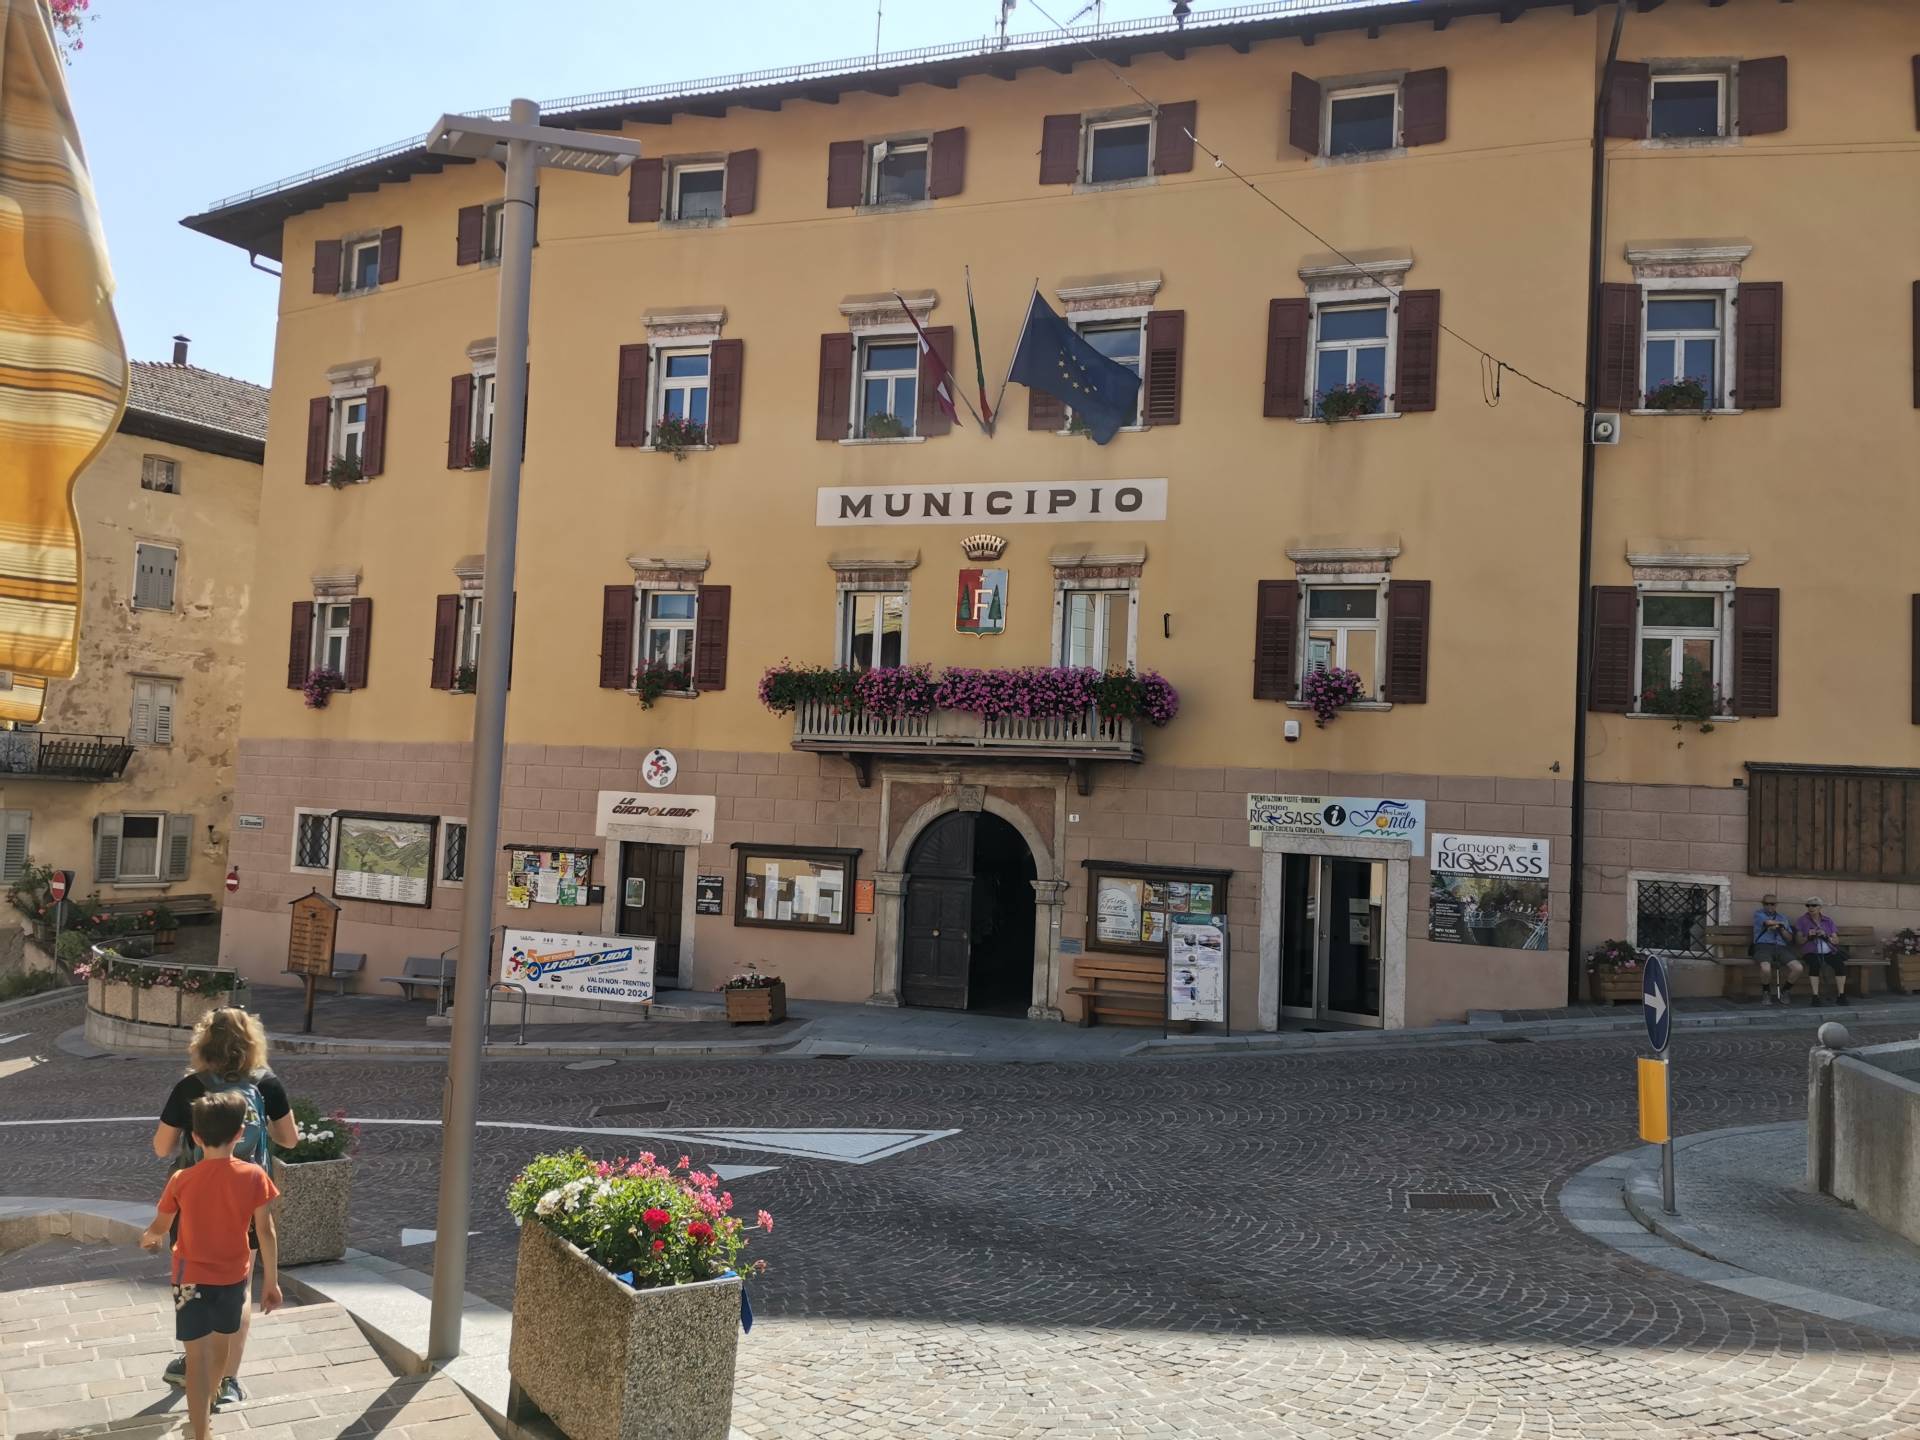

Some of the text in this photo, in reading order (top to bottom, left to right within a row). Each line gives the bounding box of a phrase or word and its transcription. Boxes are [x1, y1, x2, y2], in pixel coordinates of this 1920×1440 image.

[838, 487, 1143, 518] MUNICIPIO
[973, 589, 993, 620] F
[612, 805, 699, 817] CIASPOLADA
[1255, 801, 1289, 813] Canyon
[1283, 812, 1322, 825] SASS
[1443, 837, 1505, 856] Canyon
[1486, 854, 1543, 874] SASS
[543, 962, 558, 970] LA
[559, 951, 629, 967] CIASPOLADA
[587, 985, 625, 996] GENNAIO
[627, 988, 648, 998] 2024
[622, 979, 651, 988] TRENTINO
